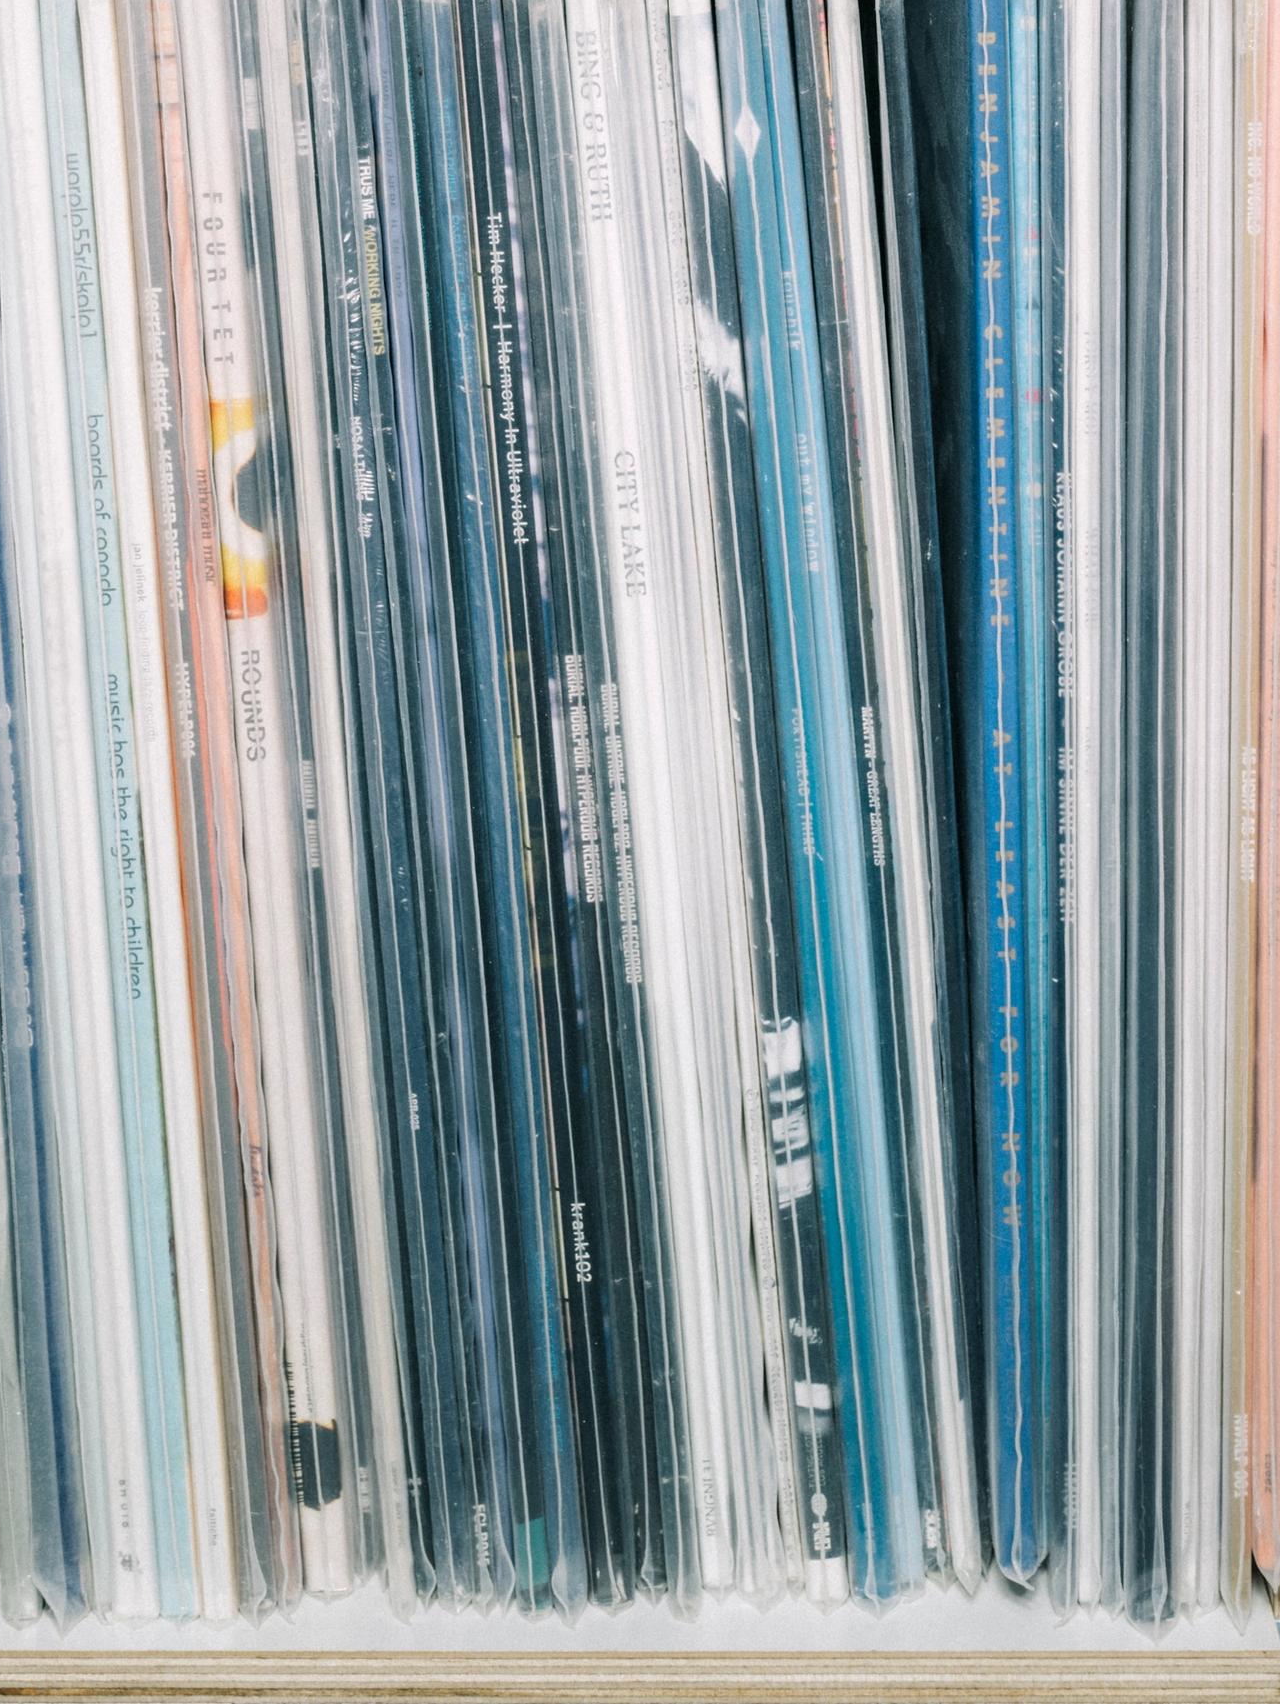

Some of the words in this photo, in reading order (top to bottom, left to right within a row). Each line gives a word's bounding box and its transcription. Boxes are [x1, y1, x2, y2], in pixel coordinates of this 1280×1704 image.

[574, 29, 599, 99] BING
[585, 143, 612, 223] RUTH
[977, 32, 1002, 280] BENJAMIN
[203, 191, 226, 284] FOUR
[365, 226, 381, 299] WORKING
[487, 212, 503, 245] Tim
[490, 251, 509, 313] Hecker
[212, 300, 236, 366] TET
[370, 302, 386, 355] NIGHTS
[496, 341, 518, 421] Harmony
[504, 428, 519, 445] In
[506, 451, 529, 545] Ultraviolet
[614, 450, 639, 513] CITY
[984, 324, 1009, 627] CLEMENTINE
[620, 525, 647, 597] LAKE
[240, 649, 266, 762] ROUNDS
[861, 707, 877, 759] MARTYN
[867, 771, 882, 809] GREAT
[991, 729, 1011, 779] AT
[870, 812, 886, 866] LENGTHS
[994, 821, 1017, 963] LEAST
[998, 1005, 1019, 1087] FOR
[1001, 1132, 1022, 1226] NOW
[570, 1202, 592, 1283] krank102
